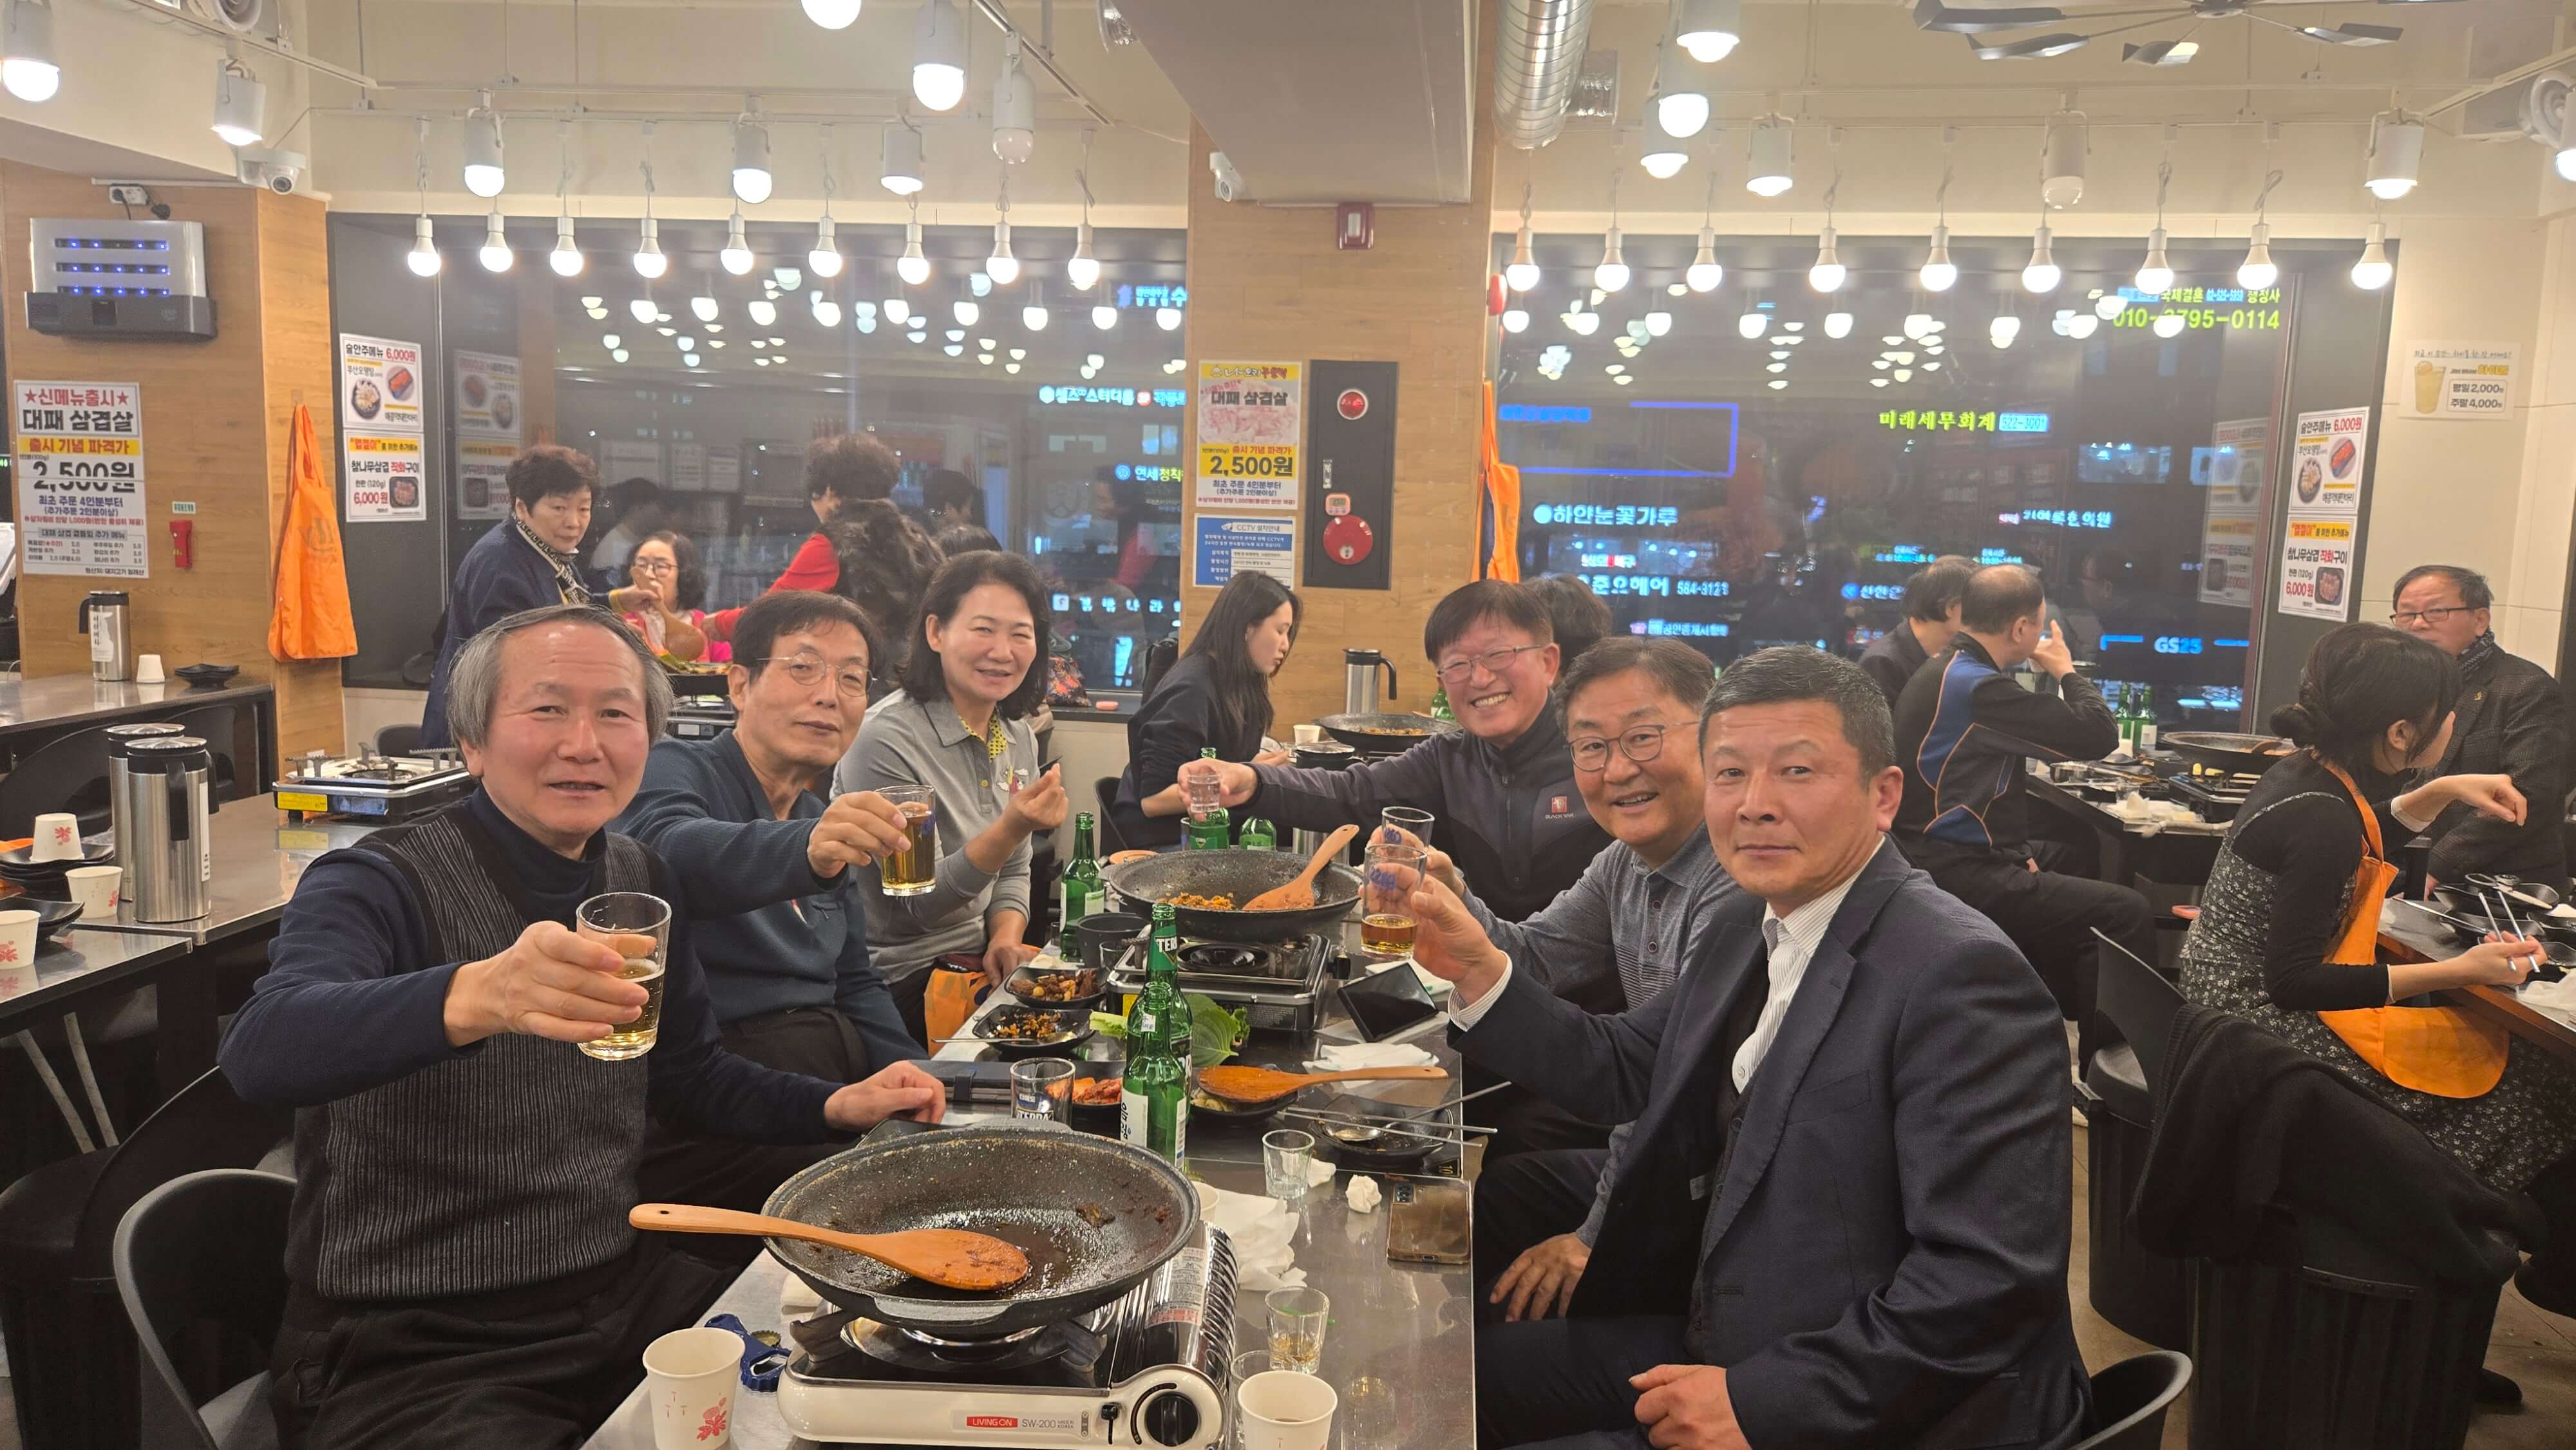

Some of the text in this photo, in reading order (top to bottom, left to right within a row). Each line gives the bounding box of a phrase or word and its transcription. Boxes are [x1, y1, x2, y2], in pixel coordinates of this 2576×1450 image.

[2113, 309, 2280, 330] 010-95-0114
[386, 347, 416, 362] 6,000원
[39, 388, 115, 407] 신메뉴출시
[1211, 391, 1288, 406] 대패 삼겹살
[23, 409, 134, 433] 대패 삼겹살
[1879, 410, 1996, 432] 미래세무회계
[2333, 417, 2363, 432] 6,000원
[29, 438, 129, 455] 출시 기념 파격가
[1232, 445, 1248, 454] 출시
[1249, 446, 1265, 454] 기념
[1267, 446, 1292, 455] 파격가
[351, 460, 419, 473] 참나무삼겹 직화구이
[1209, 455, 1293, 477] 2,500원
[33, 460, 136, 494] 2,500원
[366, 479, 386, 490] (120g)
[1213, 479, 1282, 490] 최초 주문 4인분부터
[39, 495, 124, 508] 최초 주문 4인분부터
[354, 491, 388, 506] 6,000 원
[44, 506, 118, 517] (추가주문 2인분이상)
[2287, 547, 2348, 565] 참나무삼겹 직화구이
[2297, 569, 2314, 581] (120g)
[1859, 584, 1906, 601] 신한은
[2286, 581, 2315, 598] 6,000 원
[2154, 636, 2203, 654] GS25
[972, 1417, 1012, 1427] LIVING ON
[1021, 1418, 1056, 1429] SW-200
